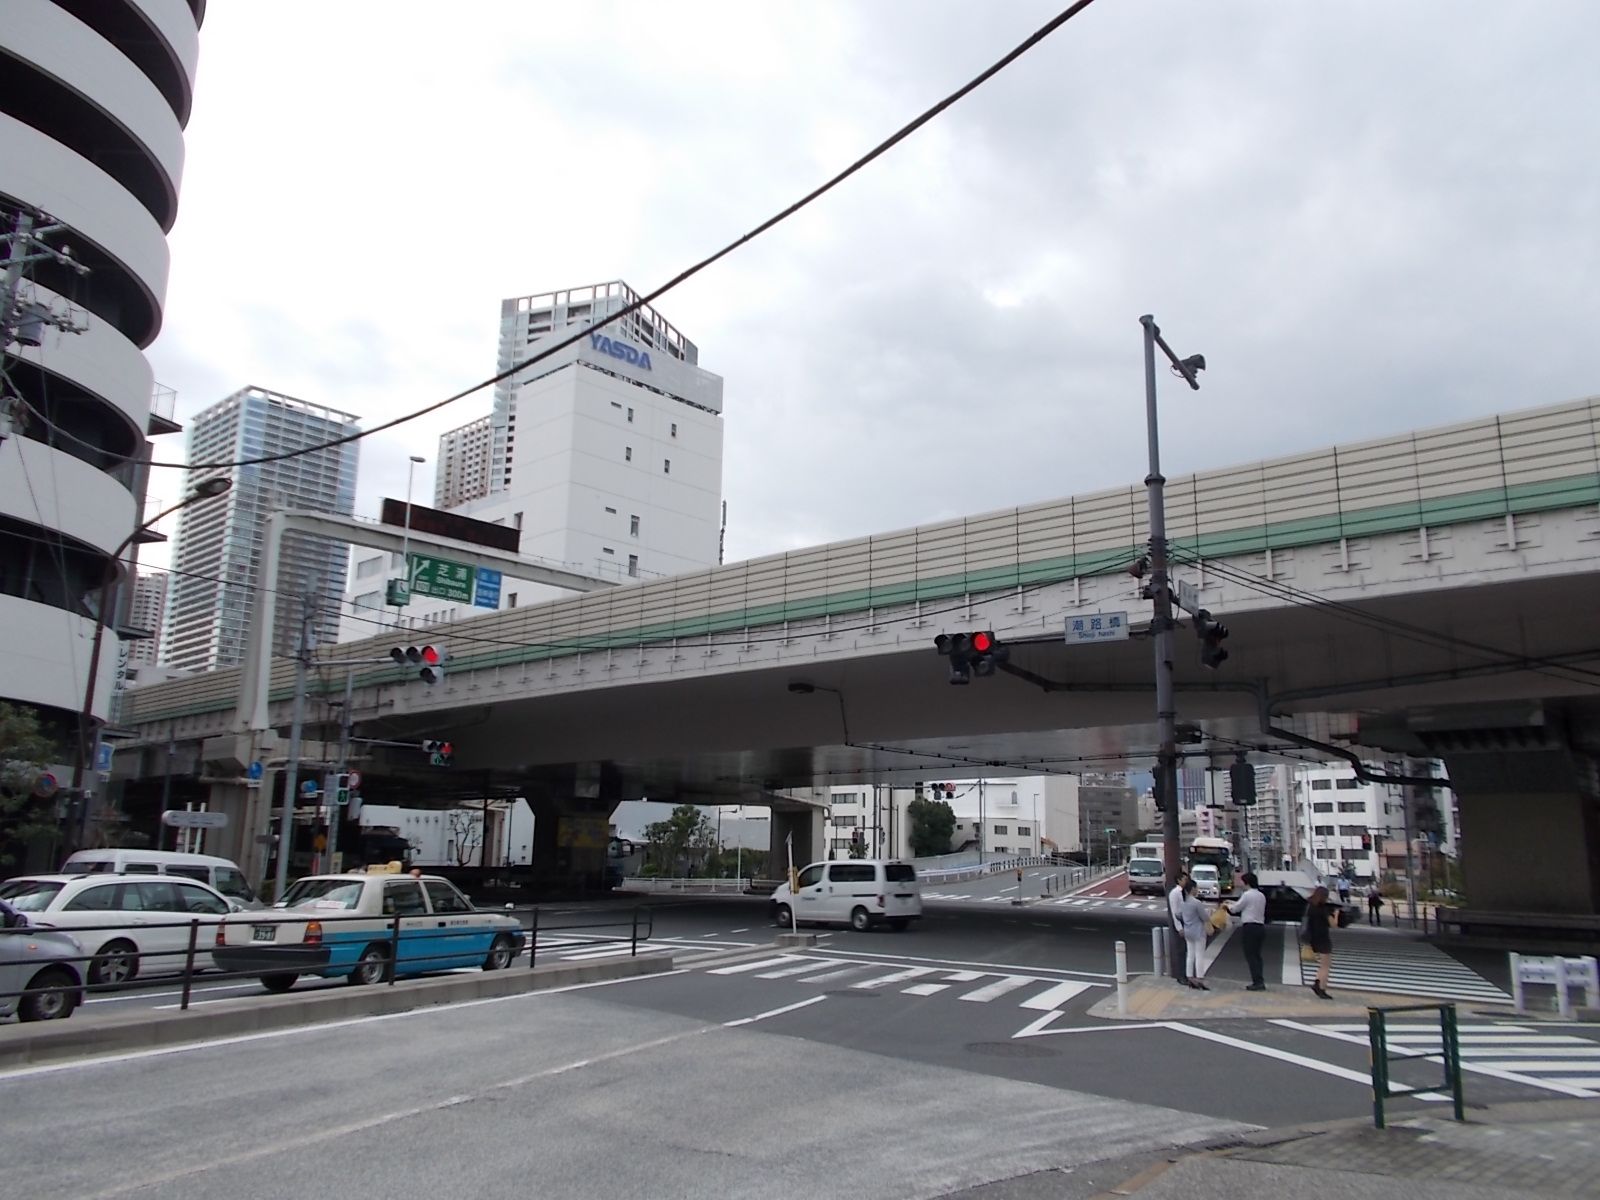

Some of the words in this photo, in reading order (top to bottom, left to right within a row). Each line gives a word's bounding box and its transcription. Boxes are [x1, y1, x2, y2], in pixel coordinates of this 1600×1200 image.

[591, 333, 652, 371] YASDA
[115, 647, 128, 690] レンタル
